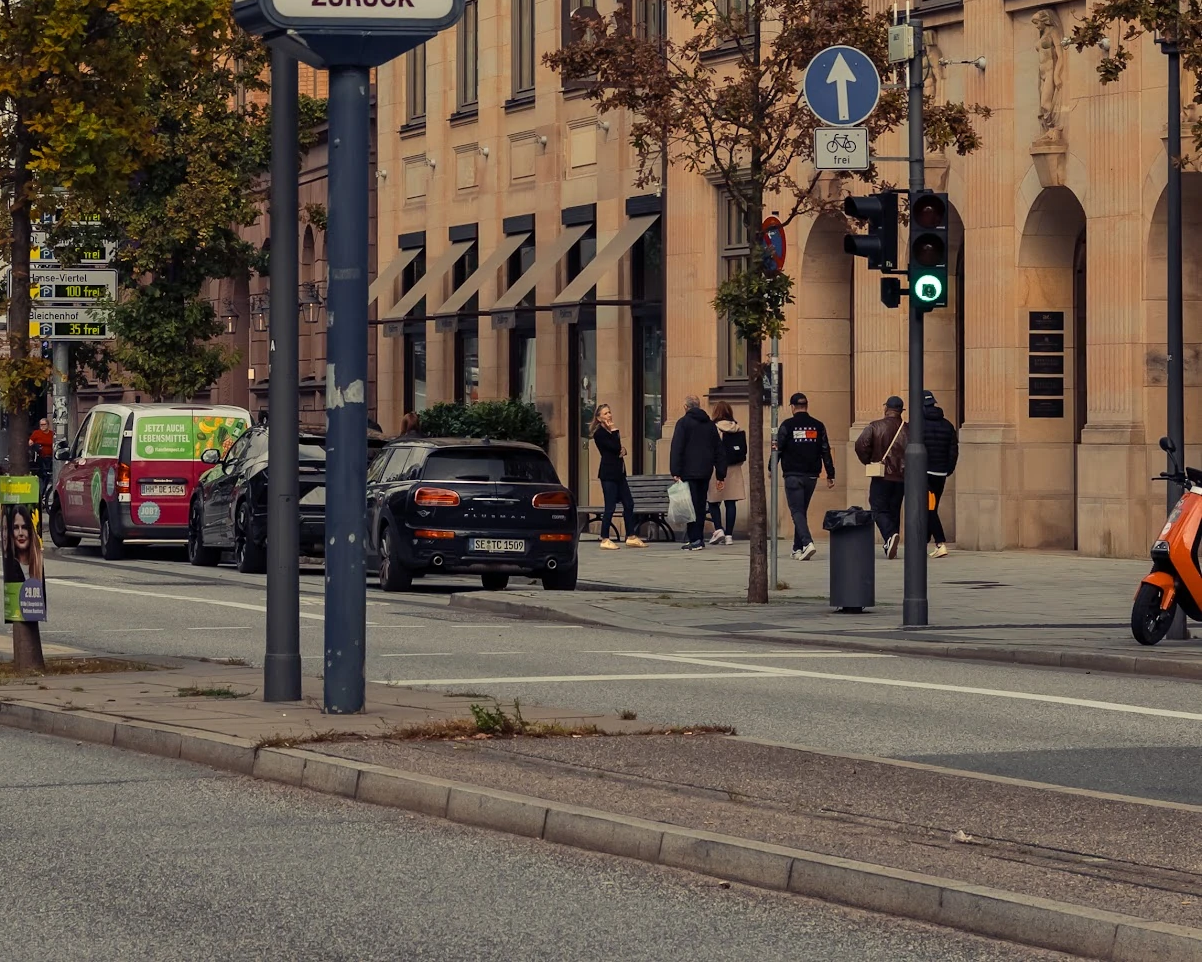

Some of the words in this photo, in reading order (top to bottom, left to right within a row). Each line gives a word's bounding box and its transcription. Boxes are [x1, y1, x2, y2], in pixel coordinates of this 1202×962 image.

[833, 155, 850, 164] frei
[29, 274, 88, 283] Hanse-Viertel
[65, 286, 81, 297] 100
[83, 286, 100, 297] frei
[29, 312, 79, 320] Bleichenhof
[69, 324, 81, 335] 35
[83, 324, 100, 335] frei
[144, 424, 165, 433] JETZT
[166, 424, 185, 432] AUCH
[138, 434, 191, 443] LEBENSMITTEL
[140, 506, 159, 515] JOB?
[475, 540, 486, 549] SE
[492, 540, 502, 550] TC
[504, 540, 524, 550] 1509
